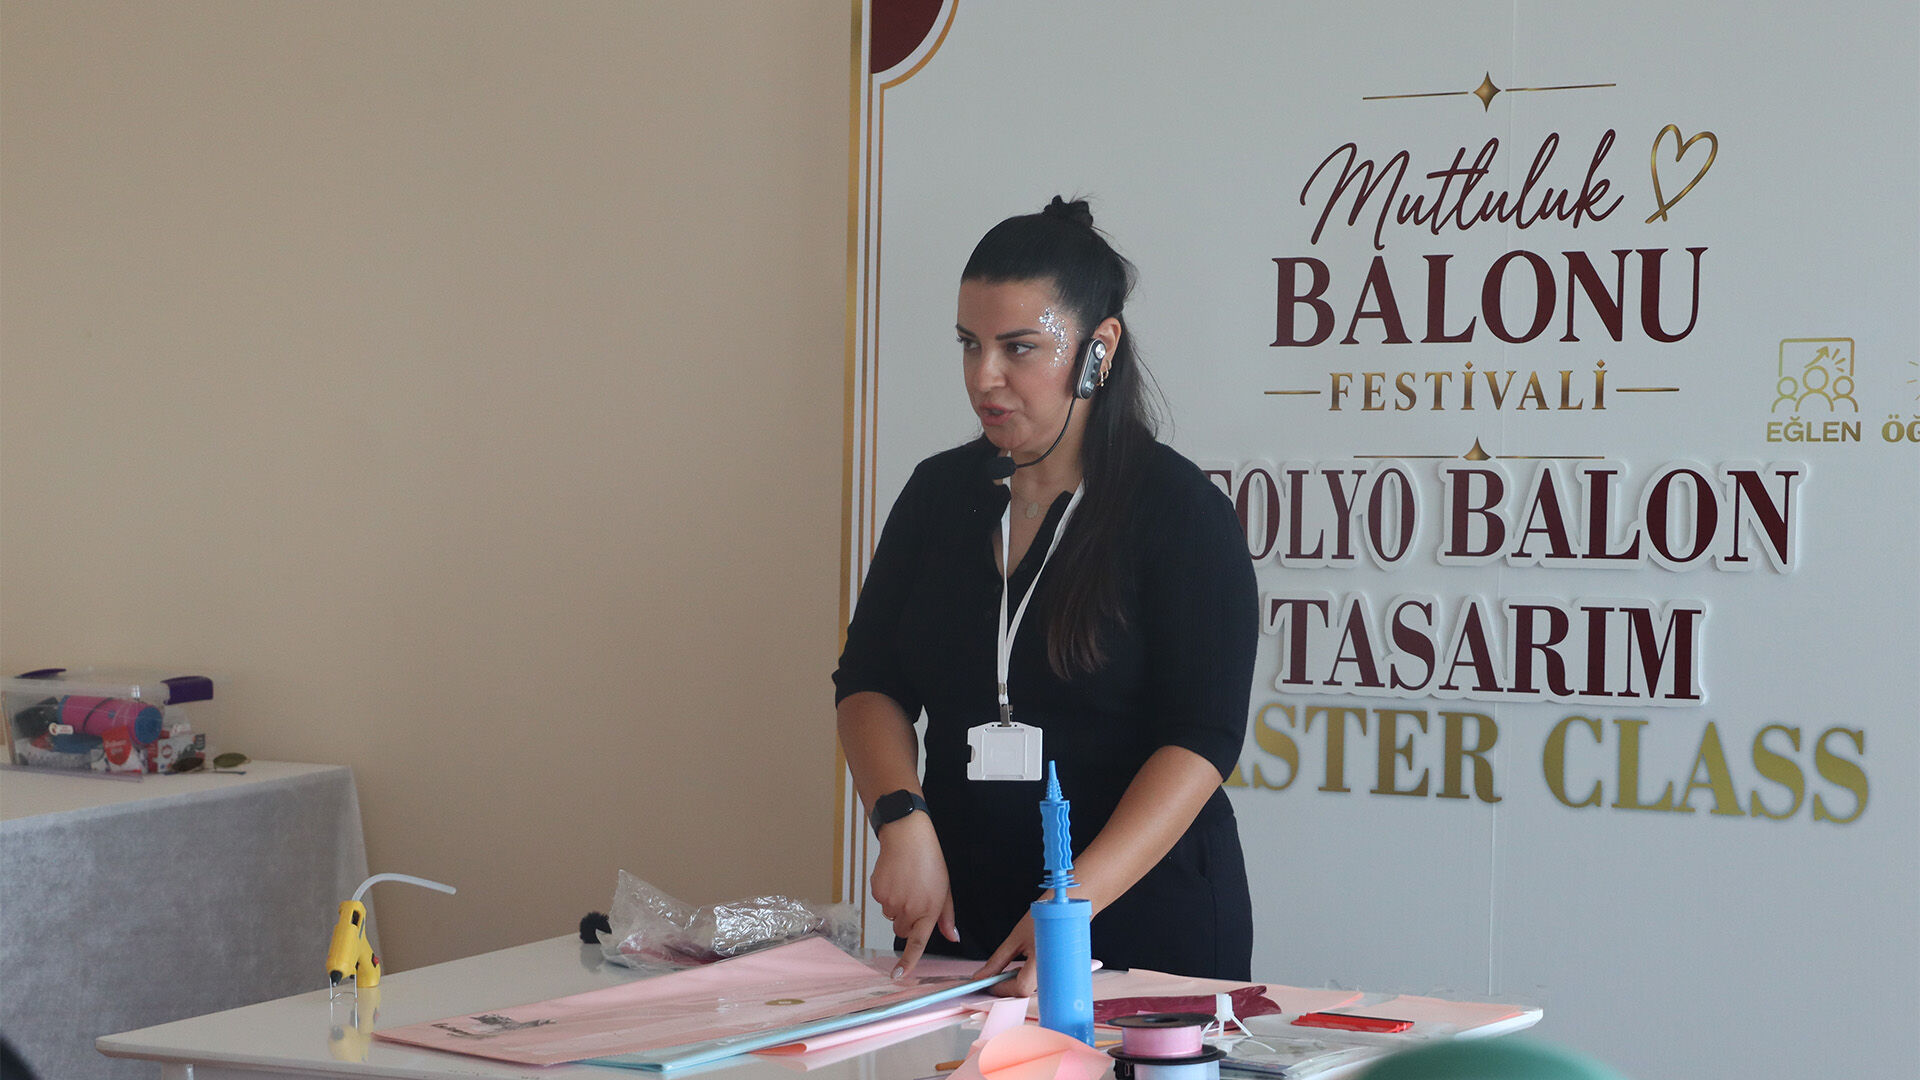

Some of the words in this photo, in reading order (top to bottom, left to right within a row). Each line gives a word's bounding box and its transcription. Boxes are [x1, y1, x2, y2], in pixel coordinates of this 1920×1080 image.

[1300, 128, 1624, 251] Mutluluk
[1269, 246, 1709, 348] BALONU
[1328, 359, 1607, 412] FESTİVALİ
[1766, 415, 1861, 443] EĞLEN
[1202, 467, 1415, 563] OLYO
[1444, 468, 1799, 565] BALON
[1269, 598, 1702, 701] TASARIM
[1221, 702, 1503, 804] STER
[1542, 714, 1870, 825] CLASS
